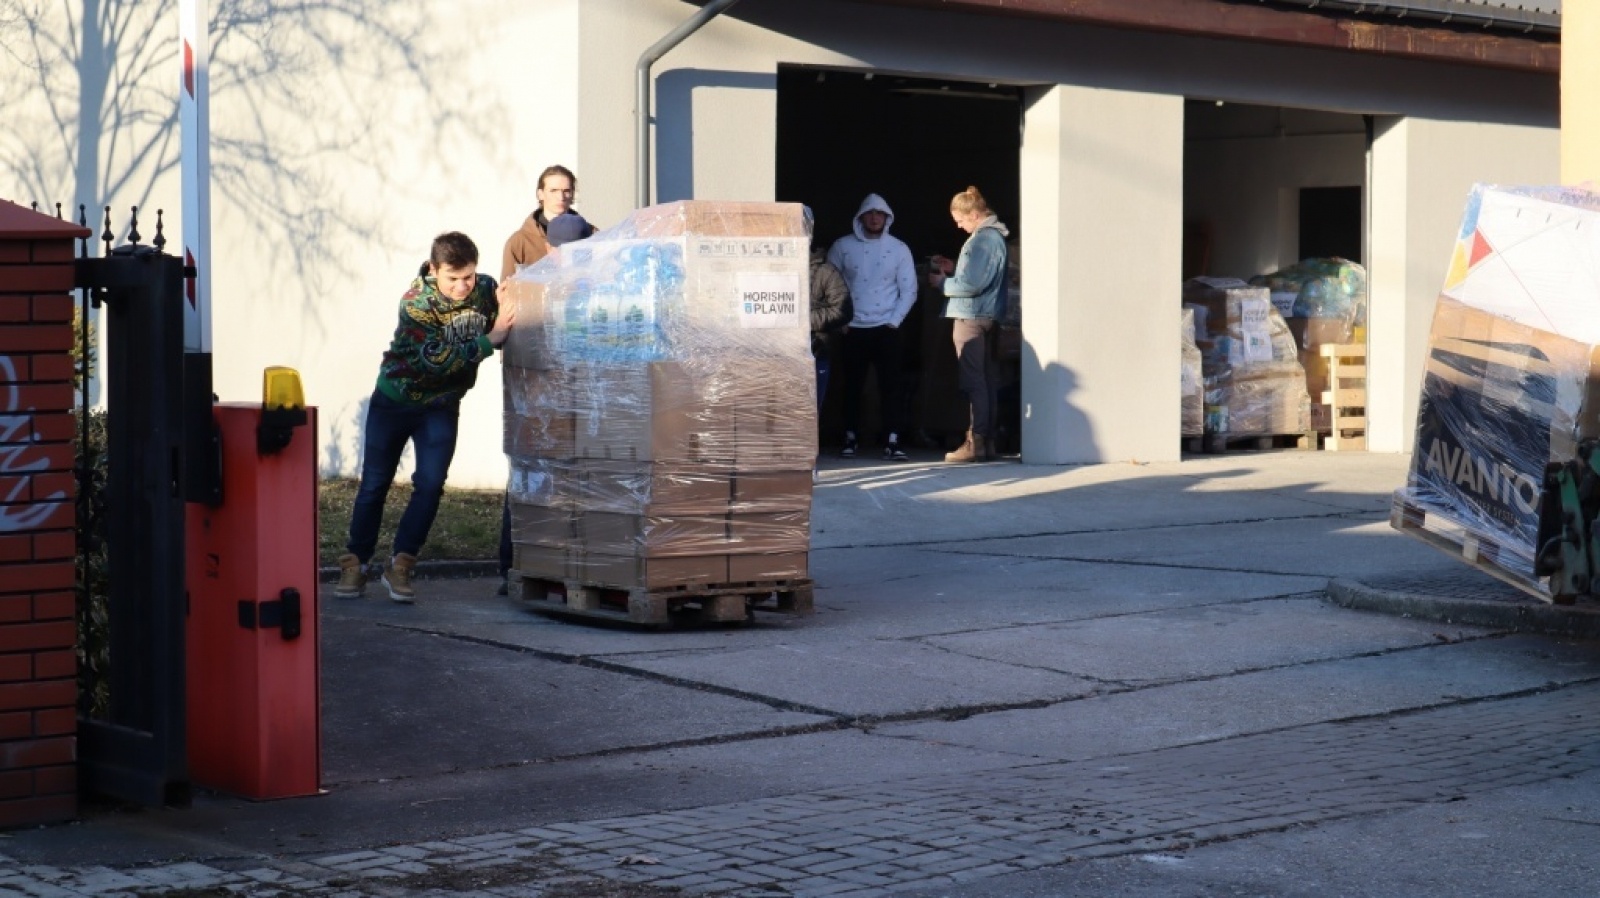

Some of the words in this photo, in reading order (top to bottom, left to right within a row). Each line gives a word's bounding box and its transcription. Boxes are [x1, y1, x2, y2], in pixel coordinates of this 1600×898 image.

[743, 291, 795, 302] HORISHNI
[754, 302, 795, 315] PLAVNI
[1424, 437, 1540, 515] AVANTO
